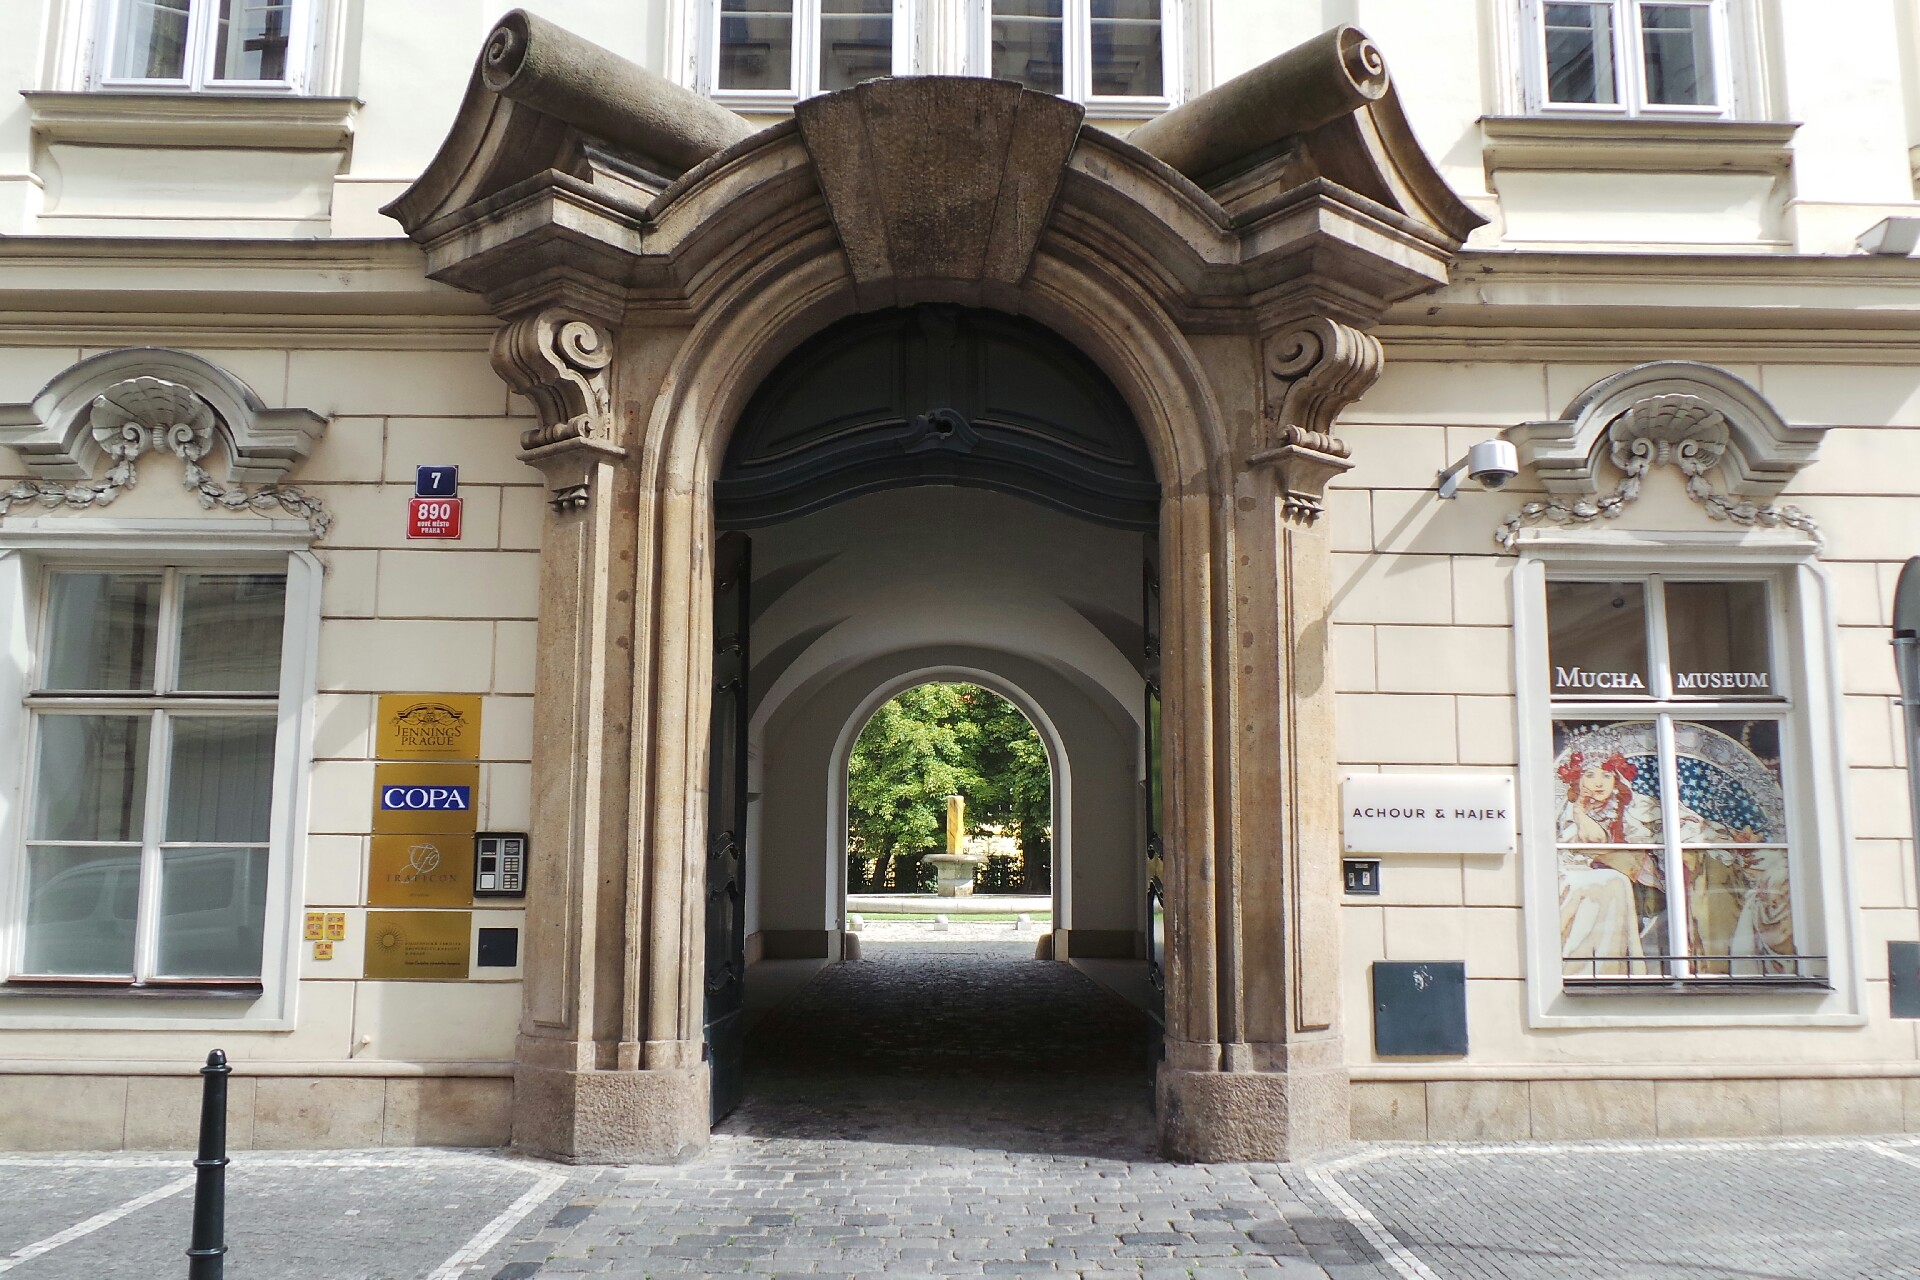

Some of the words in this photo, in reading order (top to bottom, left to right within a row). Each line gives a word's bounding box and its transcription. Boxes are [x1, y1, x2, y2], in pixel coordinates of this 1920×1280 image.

[431, 472, 442, 489] 7
[417, 503, 451, 520] 890
[1555, 667, 1646, 689] MUCHA
[1677, 672, 1769, 689] MUSEUM
[395, 725, 462, 737] JENNINGS
[401, 736, 454, 746] PRAGUE
[384, 788, 466, 809] COPA
[1352, 808, 1426, 819] ACHOUR
[1435, 808, 1446, 819] &
[1454, 809, 1508, 821] HAJEK
